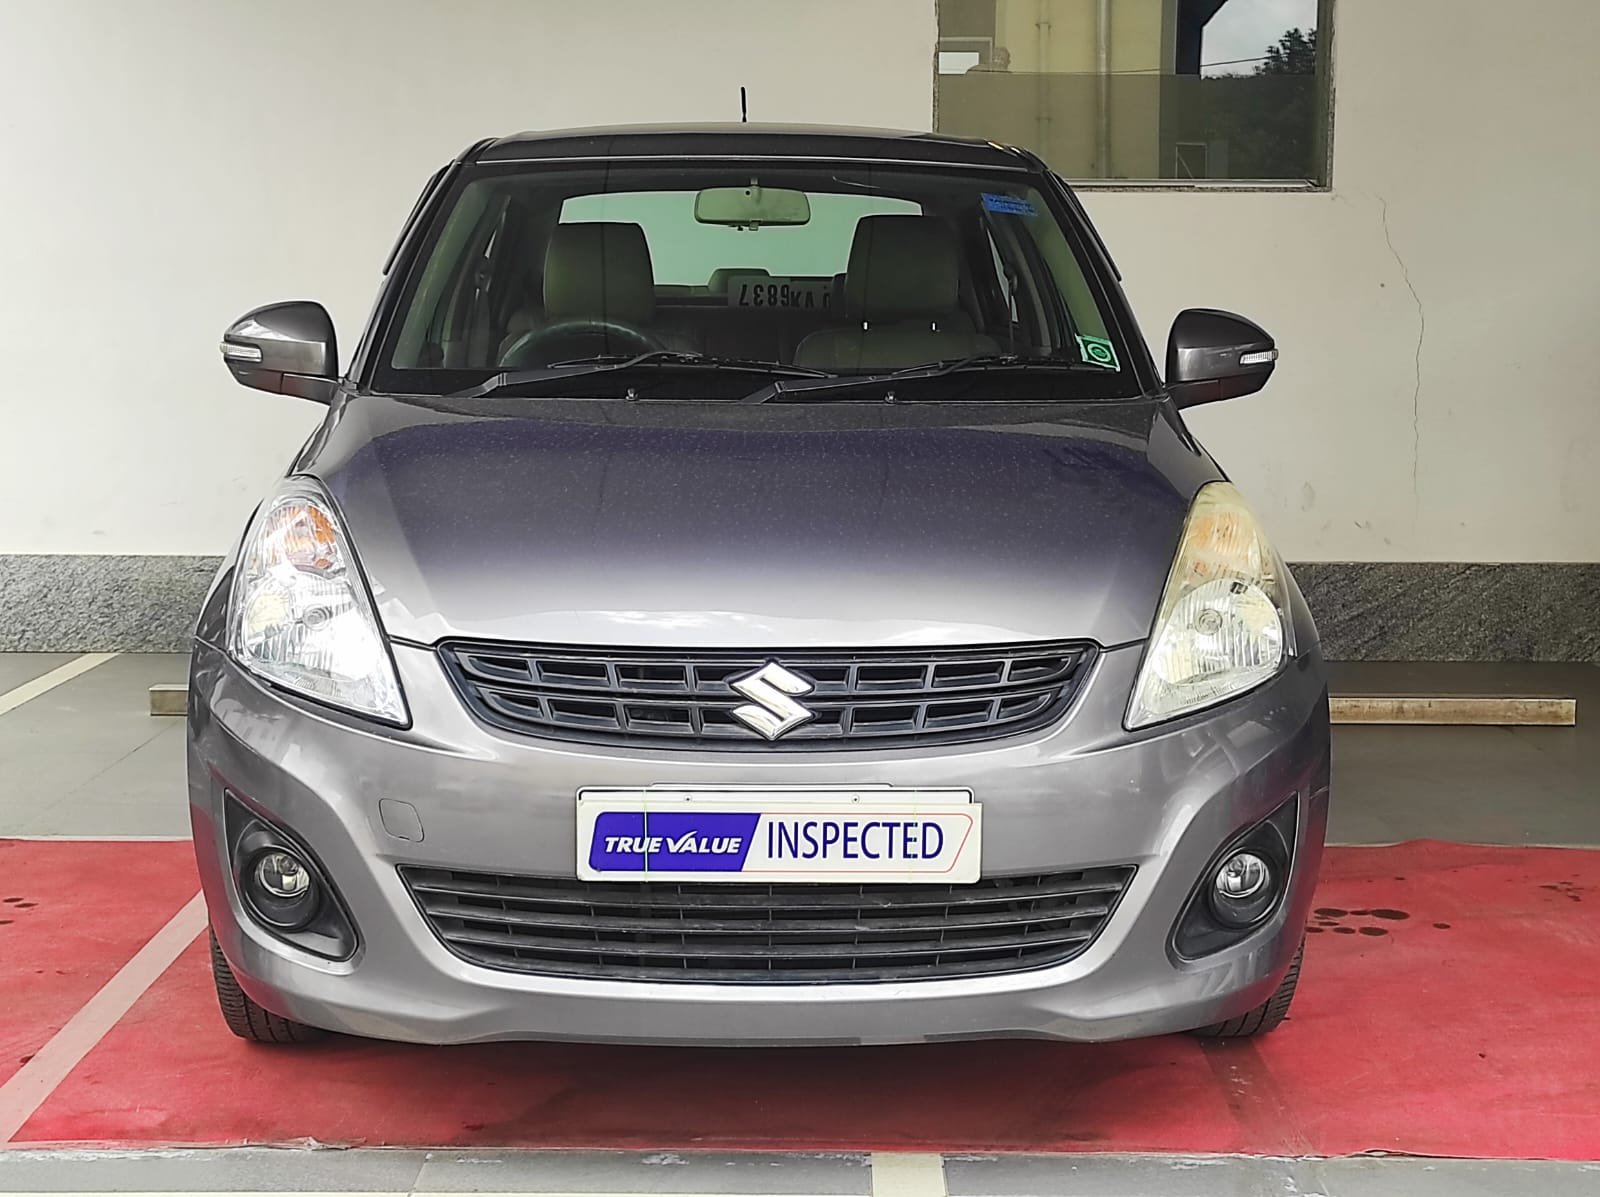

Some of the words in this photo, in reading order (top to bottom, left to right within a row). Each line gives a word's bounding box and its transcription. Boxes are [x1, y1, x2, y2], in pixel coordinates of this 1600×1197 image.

[739, 284, 790, 306] 6837
[605, 837, 663, 853] TRUE
[666, 831, 743, 853] VALUE
[768, 821, 944, 860] INSPECTED
